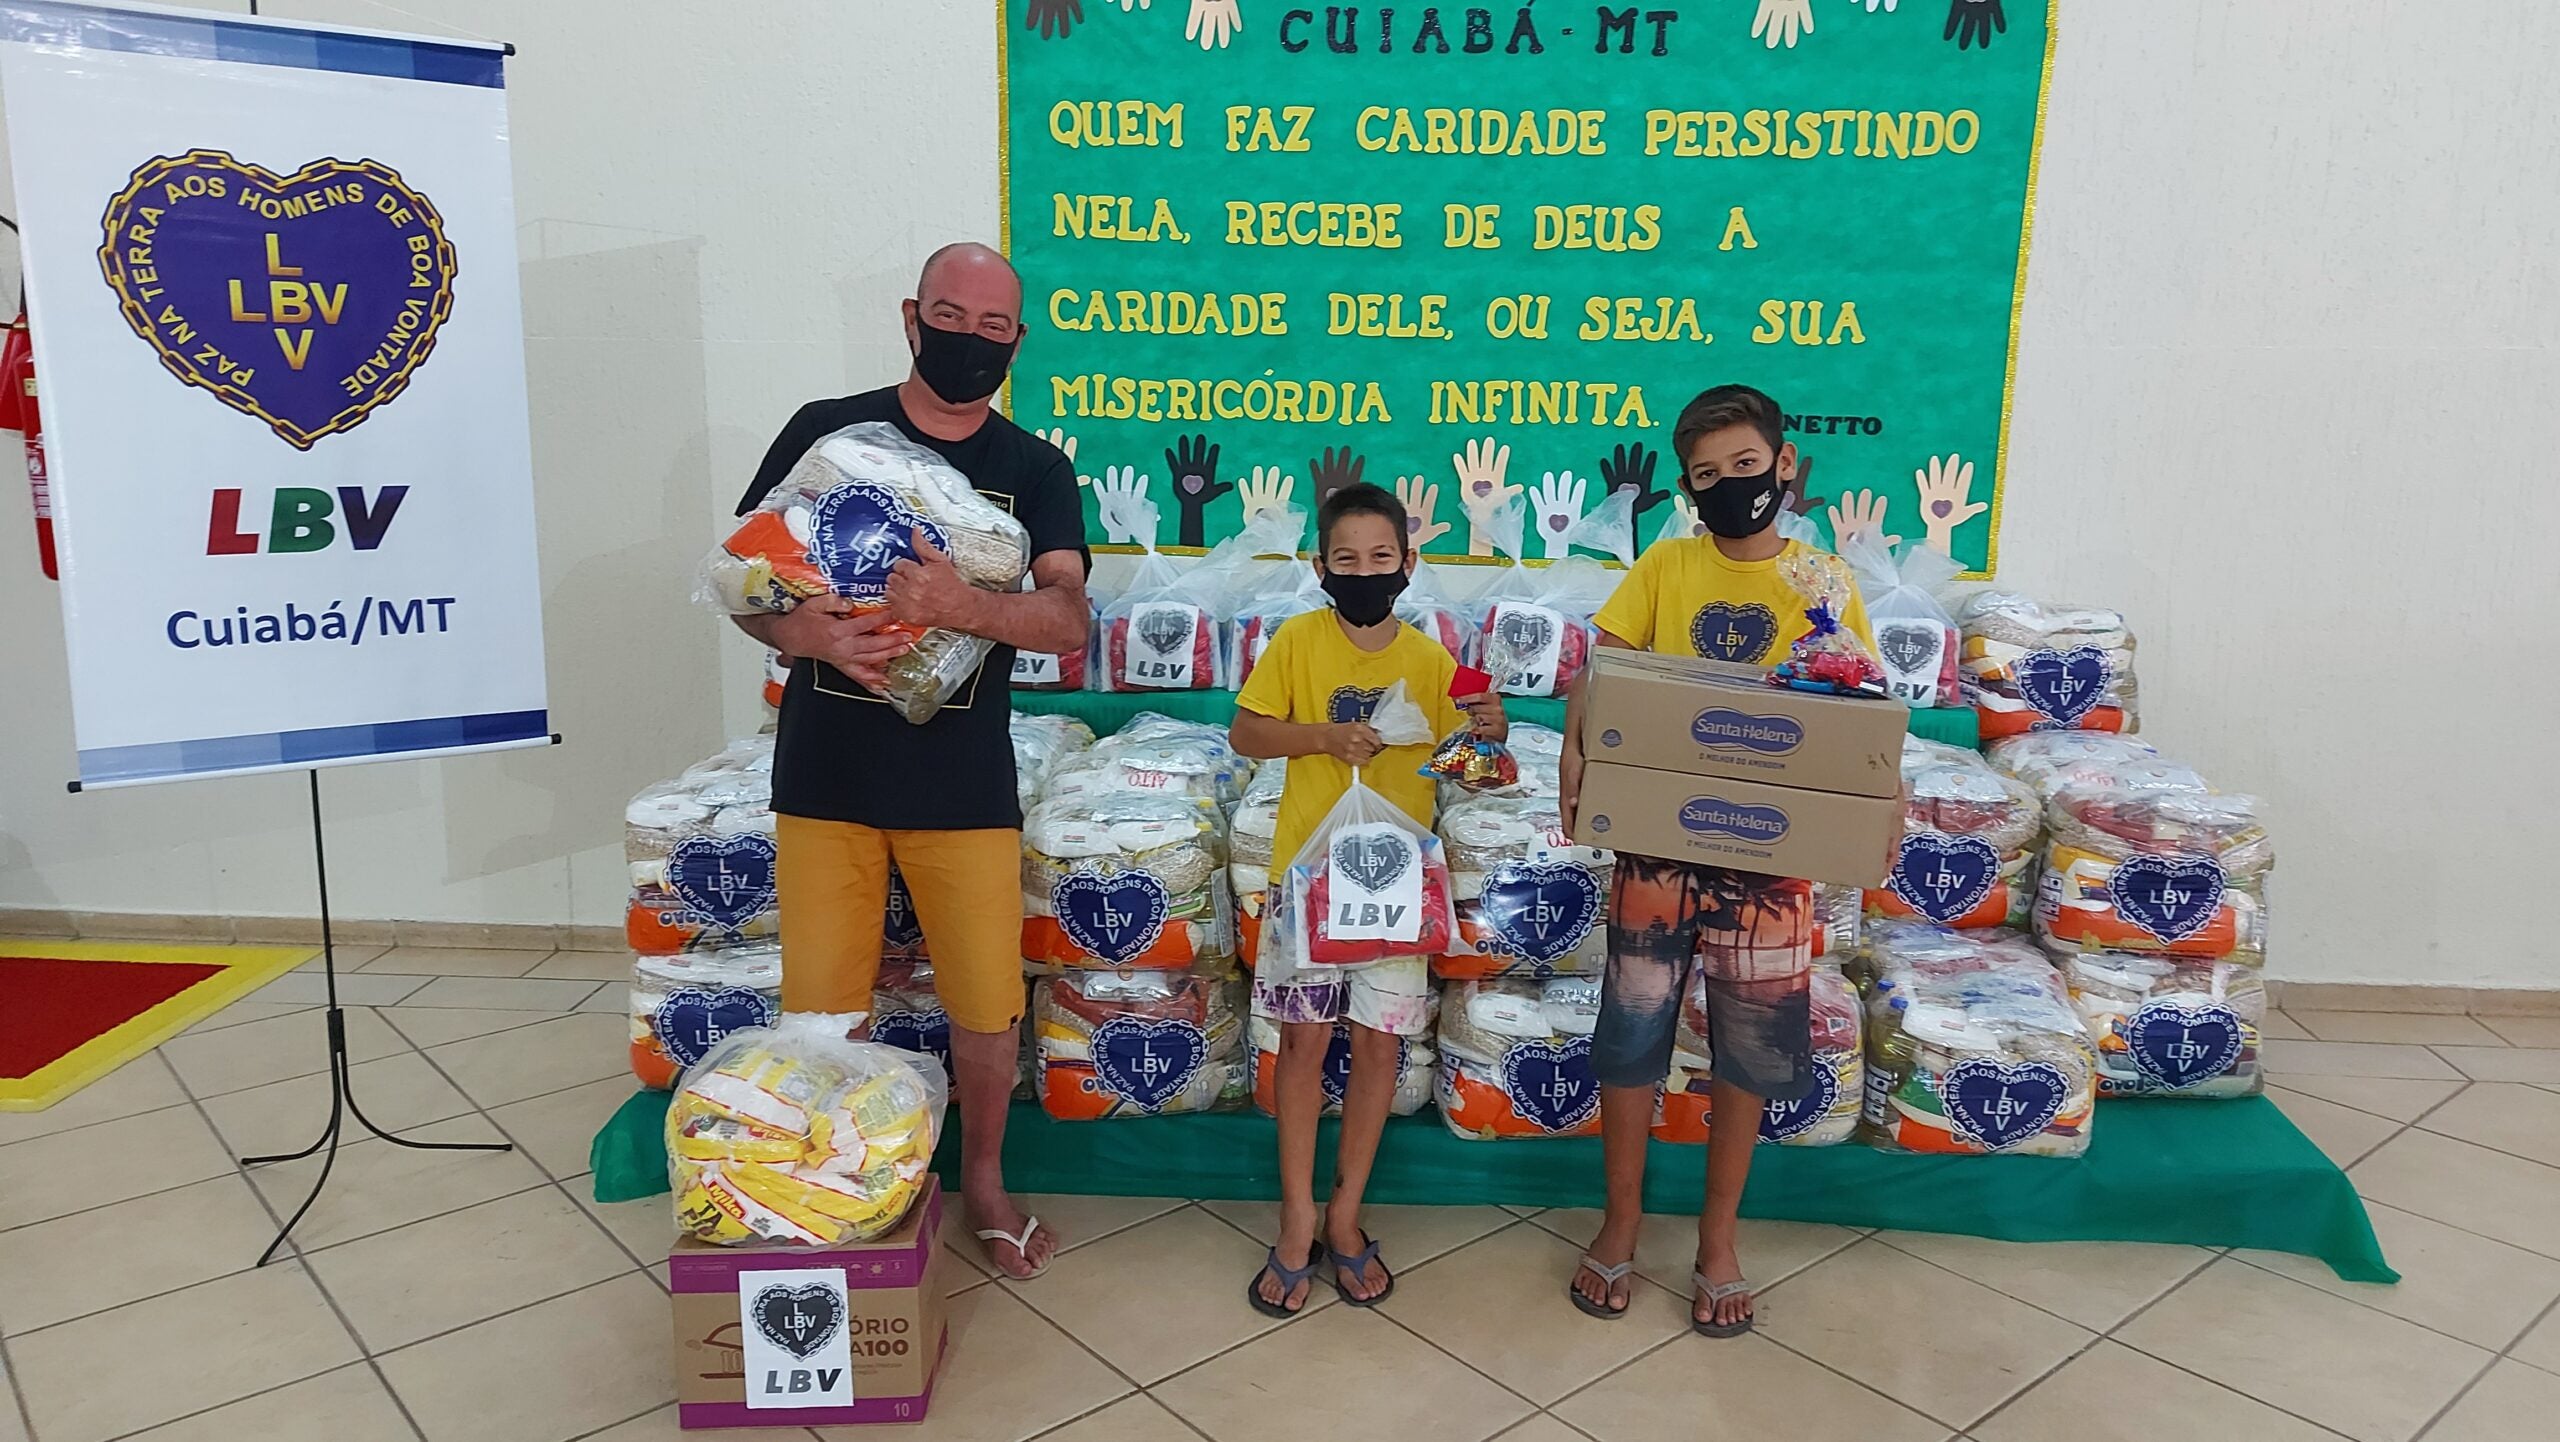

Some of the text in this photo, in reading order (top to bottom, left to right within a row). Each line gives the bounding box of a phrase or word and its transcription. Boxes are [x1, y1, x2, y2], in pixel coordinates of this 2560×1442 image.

[1280, 0, 1544, 54] CUIABÁ
[1594, 6, 1678, 56] MT
[1049, 100, 1980, 159] QUEM FAZ CARIDADE PERSISTINDO
[1053, 193, 1758, 251] NELA, RECEBE DE DEUS A
[266, 233, 303, 276] L
[129, 176, 432, 397] PAZ NA TERRA AOS HOMENS DE BOA VONTADE
[228, 279, 348, 324] LBV
[1049, 289, 1866, 346] CARIDADE DELE, OU SEJA, SUA
[274, 328, 313, 370] V
[1051, 367, 1660, 428] MISERICÓRDIA INFINITA.
[1780, 413, 1883, 437] NETTO
[206, 486, 410, 555] LBV
[822, 488, 937, 594] PAZ NA TERRA AOS HOMENS TADE
[167, 597, 455, 650] Cuiabá/MT
[1716, 633, 1748, 646] LBV
[1014, 657, 1047, 675] BV
[1137, 661, 1186, 679] LBV
[1507, 673, 1544, 688] BV
[2050, 680, 2086, 693] LBV
[1894, 682, 1931, 700] BV
[1696, 718, 1797, 744] Santa Helena
[1683, 806, 1783, 833] Santa Helena
[1360, 856, 1387, 866] LBV
[1940, 858, 1952, 873] L
[682, 841, 758, 912] PAZ NA AOS HOMENS
[707, 874, 748, 891] LBV
[1925, 872, 1966, 888] LBV
[720, 891, 735, 906] V
[1537, 888, 1549, 904] L
[1909, 885, 1984, 916] PAZ VONTADE
[1936, 888, 1950, 903] V
[2137, 863, 2214, 934] AOS HOMENS VONTADE
[2149, 889, 2191, 905] LBV
[1103, 896, 1116, 912] L
[1061, 879, 1161, 957] PAZ NA TERRA AOS HOMENS DE BOA VONTADE
[1093, 912, 1133, 928] LBV
[1338, 903, 1407, 928] LBV
[1506, 871, 1593, 955] PAZ HOMENS DE BOA VONTADE
[1523, 905, 1565, 922] LBV
[2161, 905, 2176, 920] V
[1105, 928, 1120, 944] V
[1534, 923, 1549, 940] V
[663, 996, 762, 1038] TERRA AOS HOMENS DE
[707, 1012, 719, 1028] L
[889, 1018, 948, 1032] AOS HOMEN
[2152, 1012, 2225, 1027] AOS HOMENS
[2183, 1029, 2195, 1044] L
[1144, 1041, 1156, 1057] L
[2166, 1043, 2210, 1059] LBV
[1098, 1031, 1201, 1101] PAZ NA TERRA DE BOA VONTADE
[1131, 1058, 1172, 1073] LBV
[1555, 1065, 1566, 1082] L
[1969, 1068, 1996, 1079] AOS
[2177, 1059, 2192, 1073] V
[1142, 1073, 1157, 1088] V
[1509, 1046, 1600, 1125] PAZ NA TERRA AOS HOMENS VONTADE
[1996, 1072, 2047, 1085] HOMENS
[2046, 1078, 2062, 1093] DE
[1541, 1080, 1580, 1097] LBV
[1949, 1072, 1970, 1106] TERRA
[2001, 1087, 2013, 1100] L
[1552, 1098, 1566, 1112] V
[1763, 1099, 1801, 1113] BV
[1774, 1070, 1833, 1136] DE BOA VONTADE
[1983, 1099, 2029, 1115] LBV
[1769, 1112, 1785, 1125] V
[1955, 1105, 1972, 1120] NA
[1966, 1119, 1986, 1135] PAZ
[1995, 1116, 2011, 1131] V
[2000, 1112, 2050, 1141] VONTADE
[711, 1183, 744, 1219] Mika
[770, 1291, 788, 1299] AOS
[794, 1303, 804, 1315] L
[784, 1315, 816, 1329] LBV
[849, 1315, 909, 1335] ÓRIO
[794, 1329, 806, 1341] V
[850, 1340, 909, 1356] A100
[765, 1368, 843, 1393] LBV
[894, 1402, 909, 1417] 10
